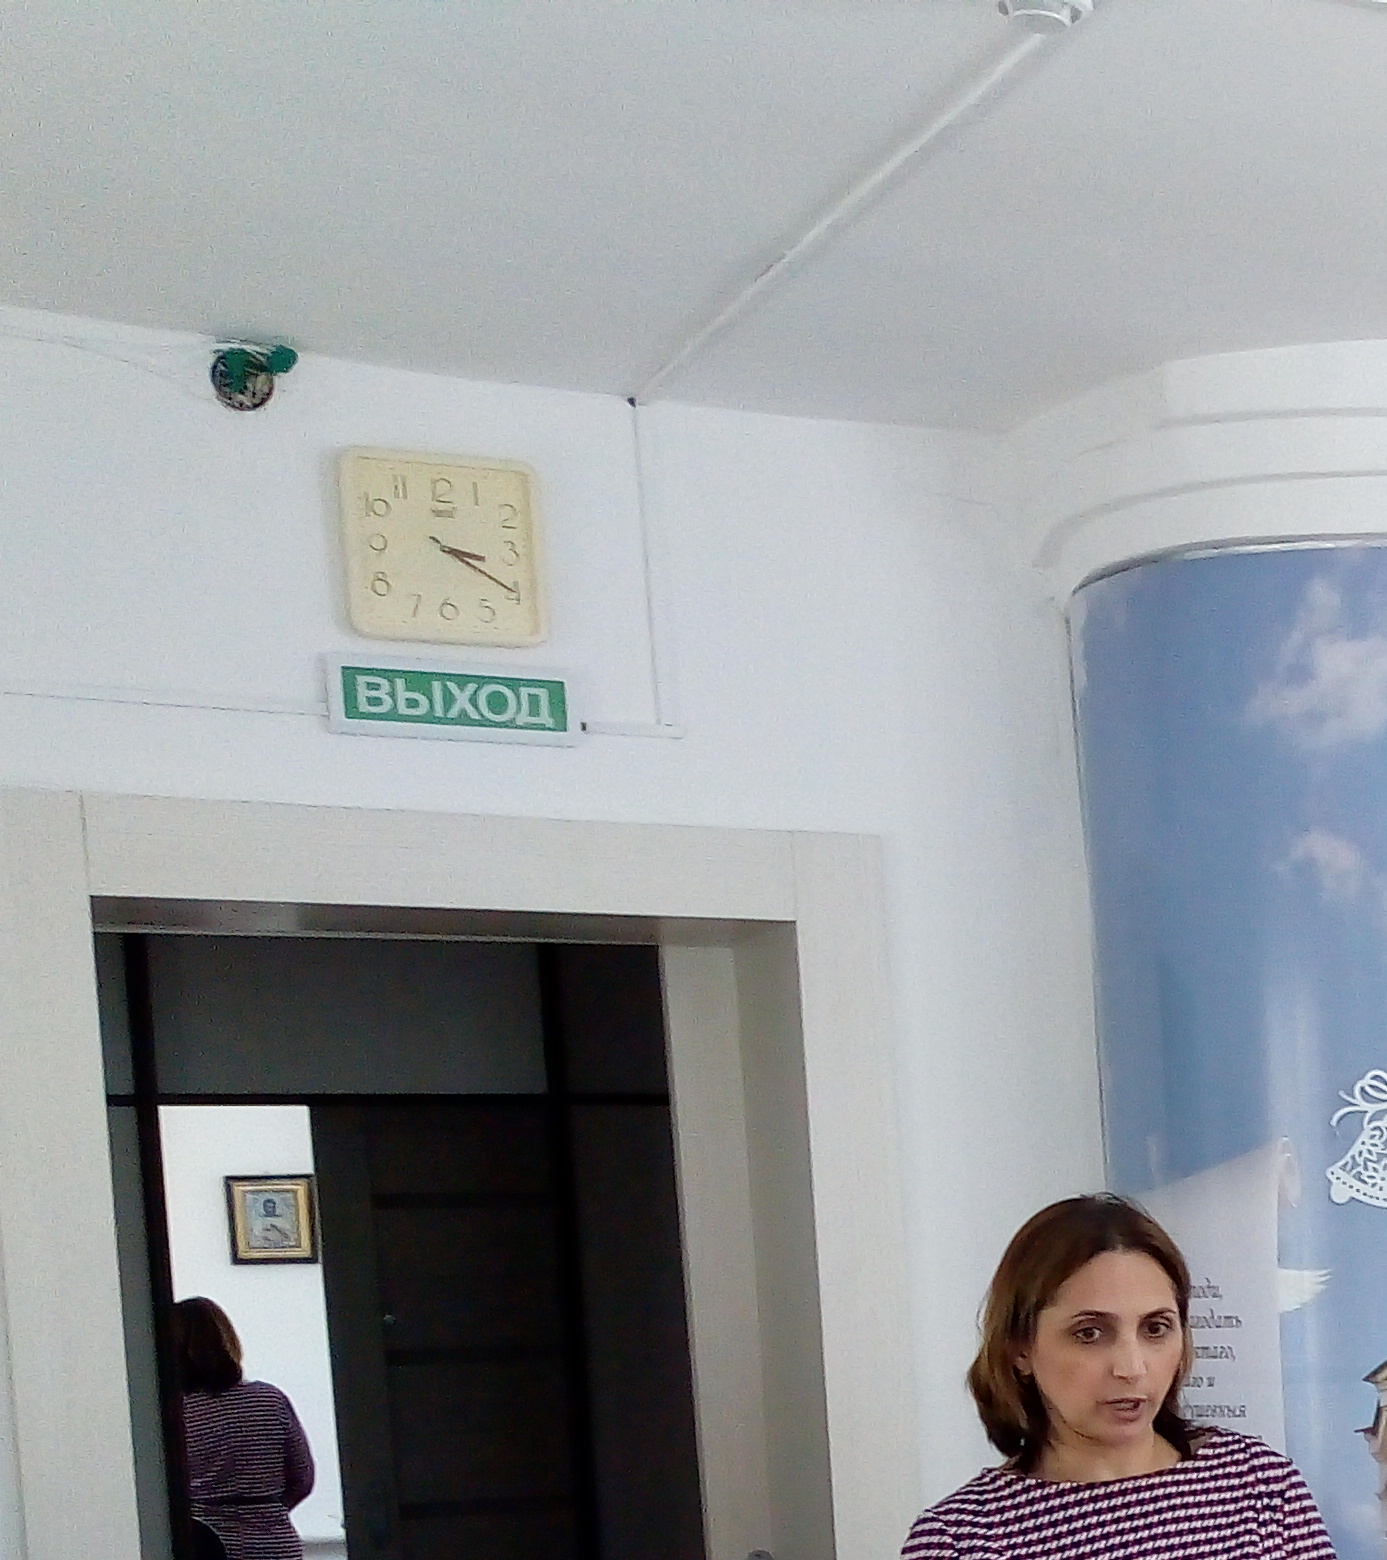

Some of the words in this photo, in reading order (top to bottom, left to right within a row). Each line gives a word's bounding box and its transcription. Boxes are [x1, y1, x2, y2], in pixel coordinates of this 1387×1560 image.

[497, 502, 520, 530] 2
[501, 538, 521, 567] 3
[369, 570, 393, 597] 8
[437, 596, 461, 622] 6
[476, 597, 498, 624] 5
[354, 674, 557, 728] ВЫХОД
